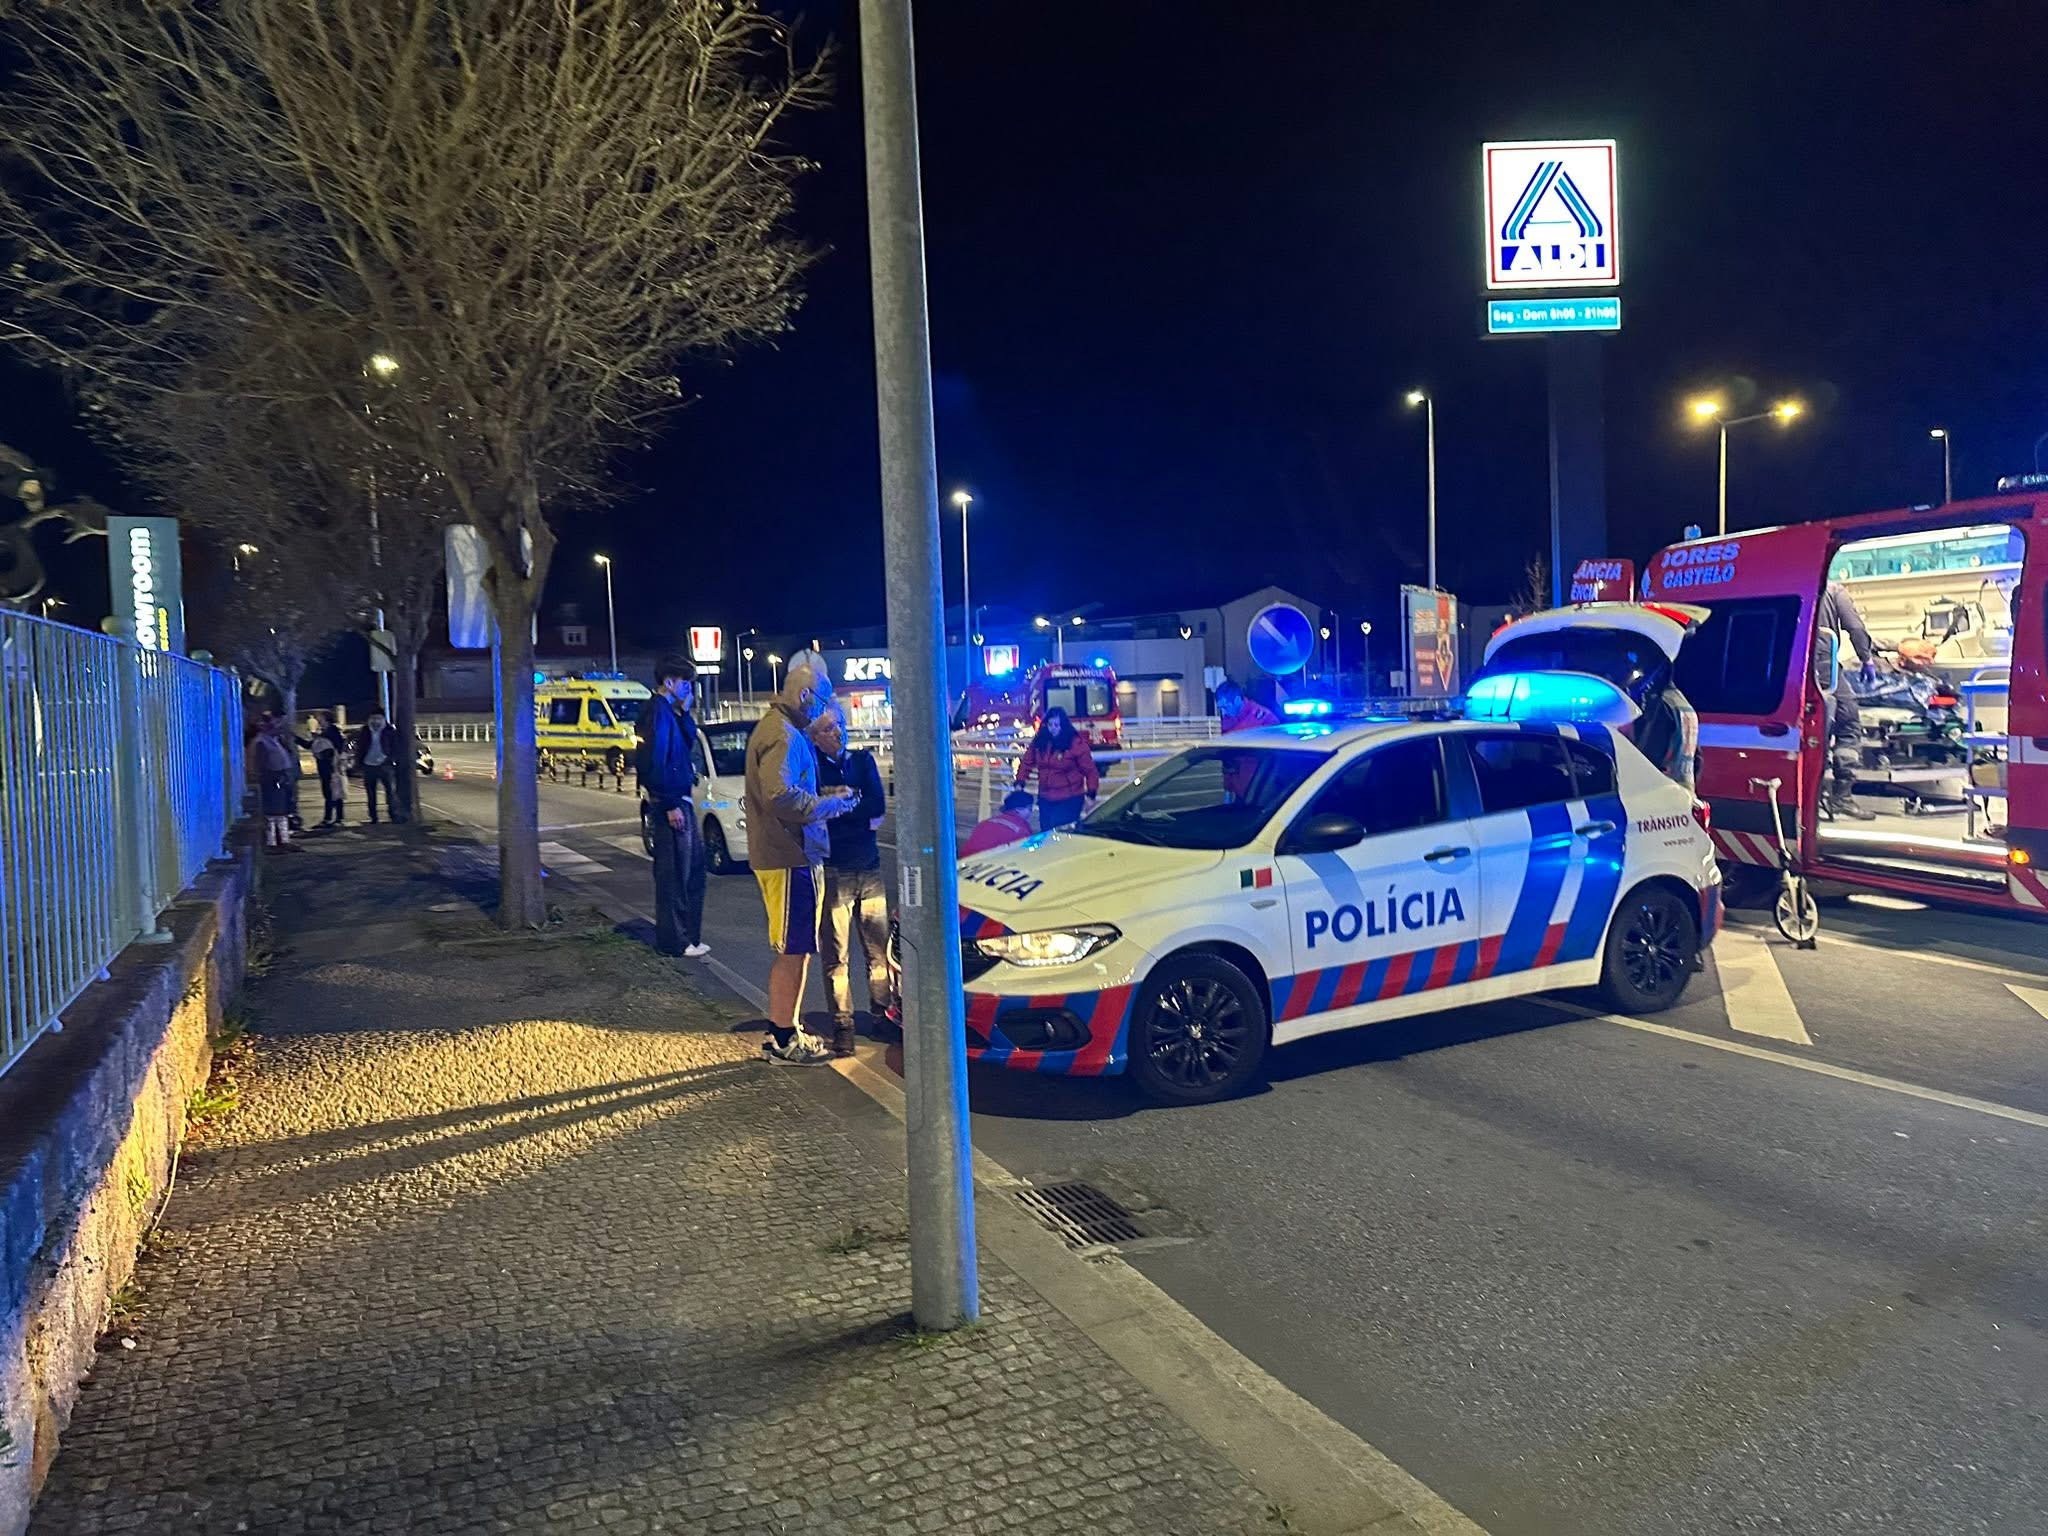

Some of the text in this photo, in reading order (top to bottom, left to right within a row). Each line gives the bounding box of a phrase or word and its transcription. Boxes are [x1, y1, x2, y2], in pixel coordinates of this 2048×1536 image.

[1504, 244, 1600, 270] ALDI
[1522, 309, 1548, 321] Dom
[1663, 563, 1735, 589] CASTELO
[1305, 884, 1465, 948] POLÍCIA
